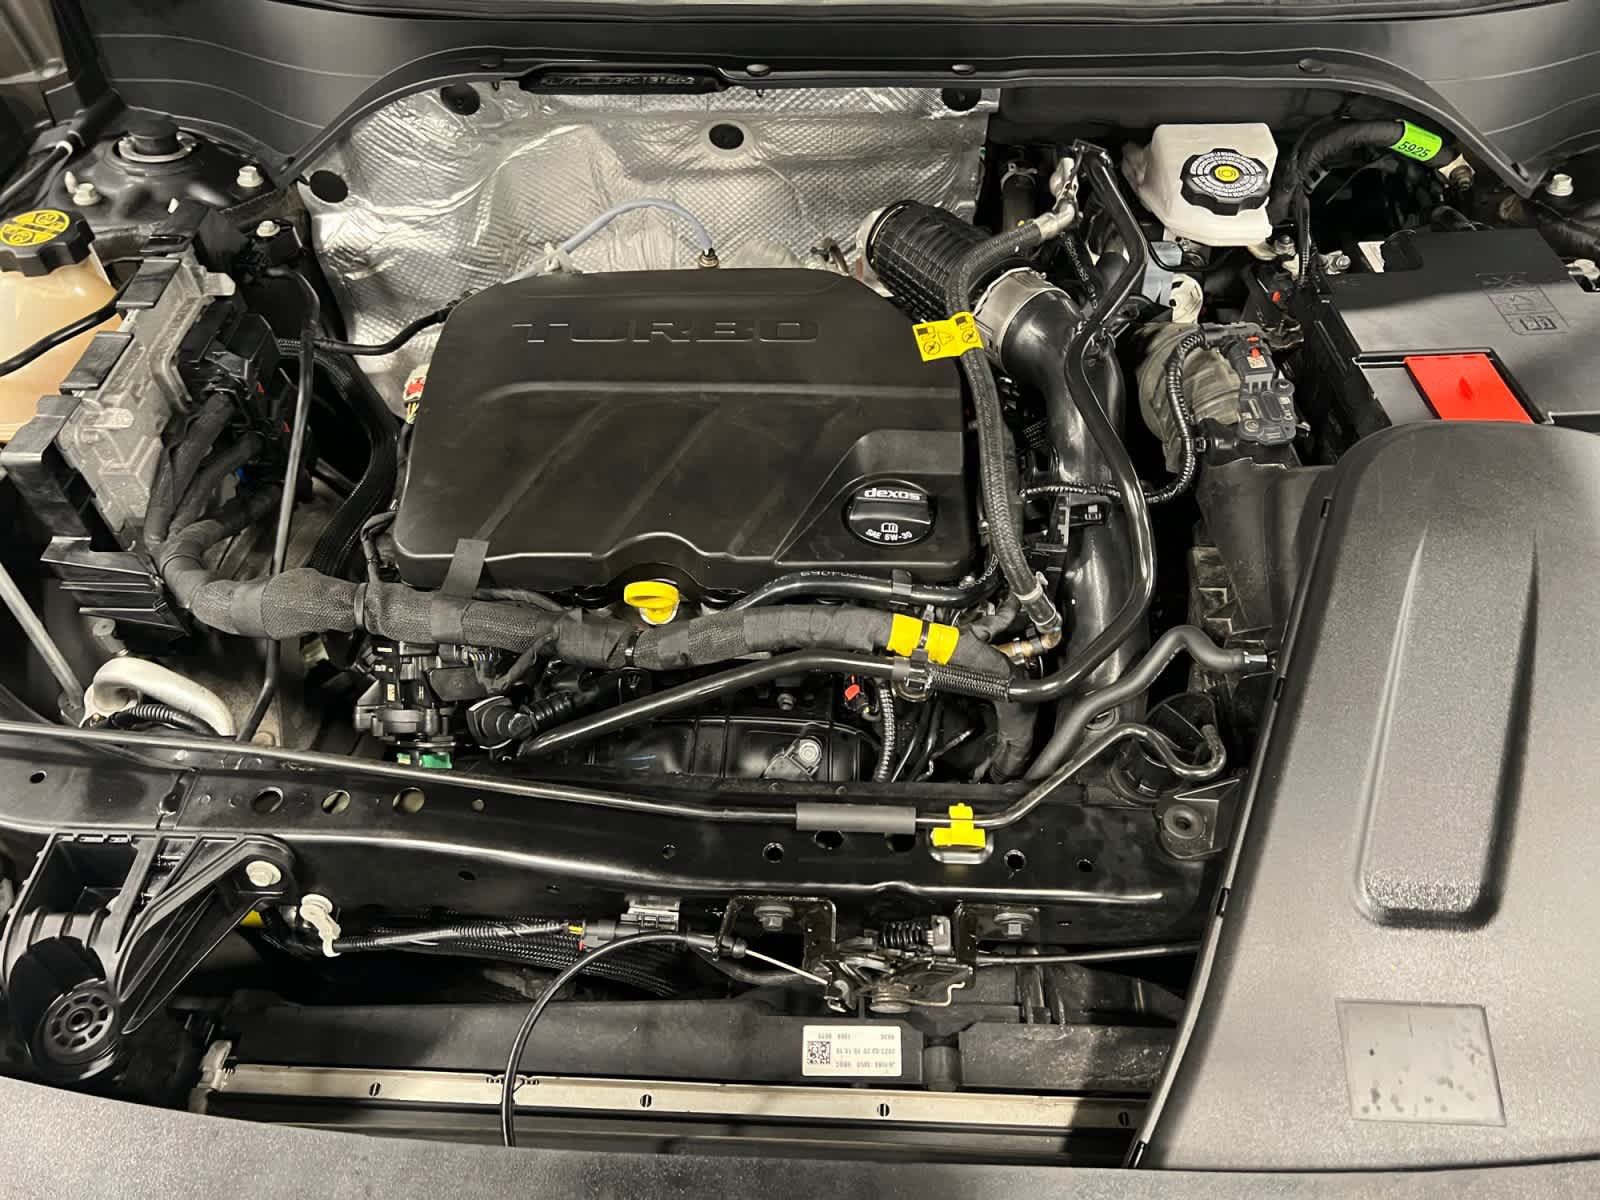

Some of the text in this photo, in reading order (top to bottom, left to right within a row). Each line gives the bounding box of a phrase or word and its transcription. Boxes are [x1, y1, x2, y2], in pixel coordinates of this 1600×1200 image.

[1398, 141, 1431, 158] 5925
[511, 320, 818, 343] TURBO
[864, 487, 921, 501] dexos
[865, 528, 913, 541] SAE 5W-30
